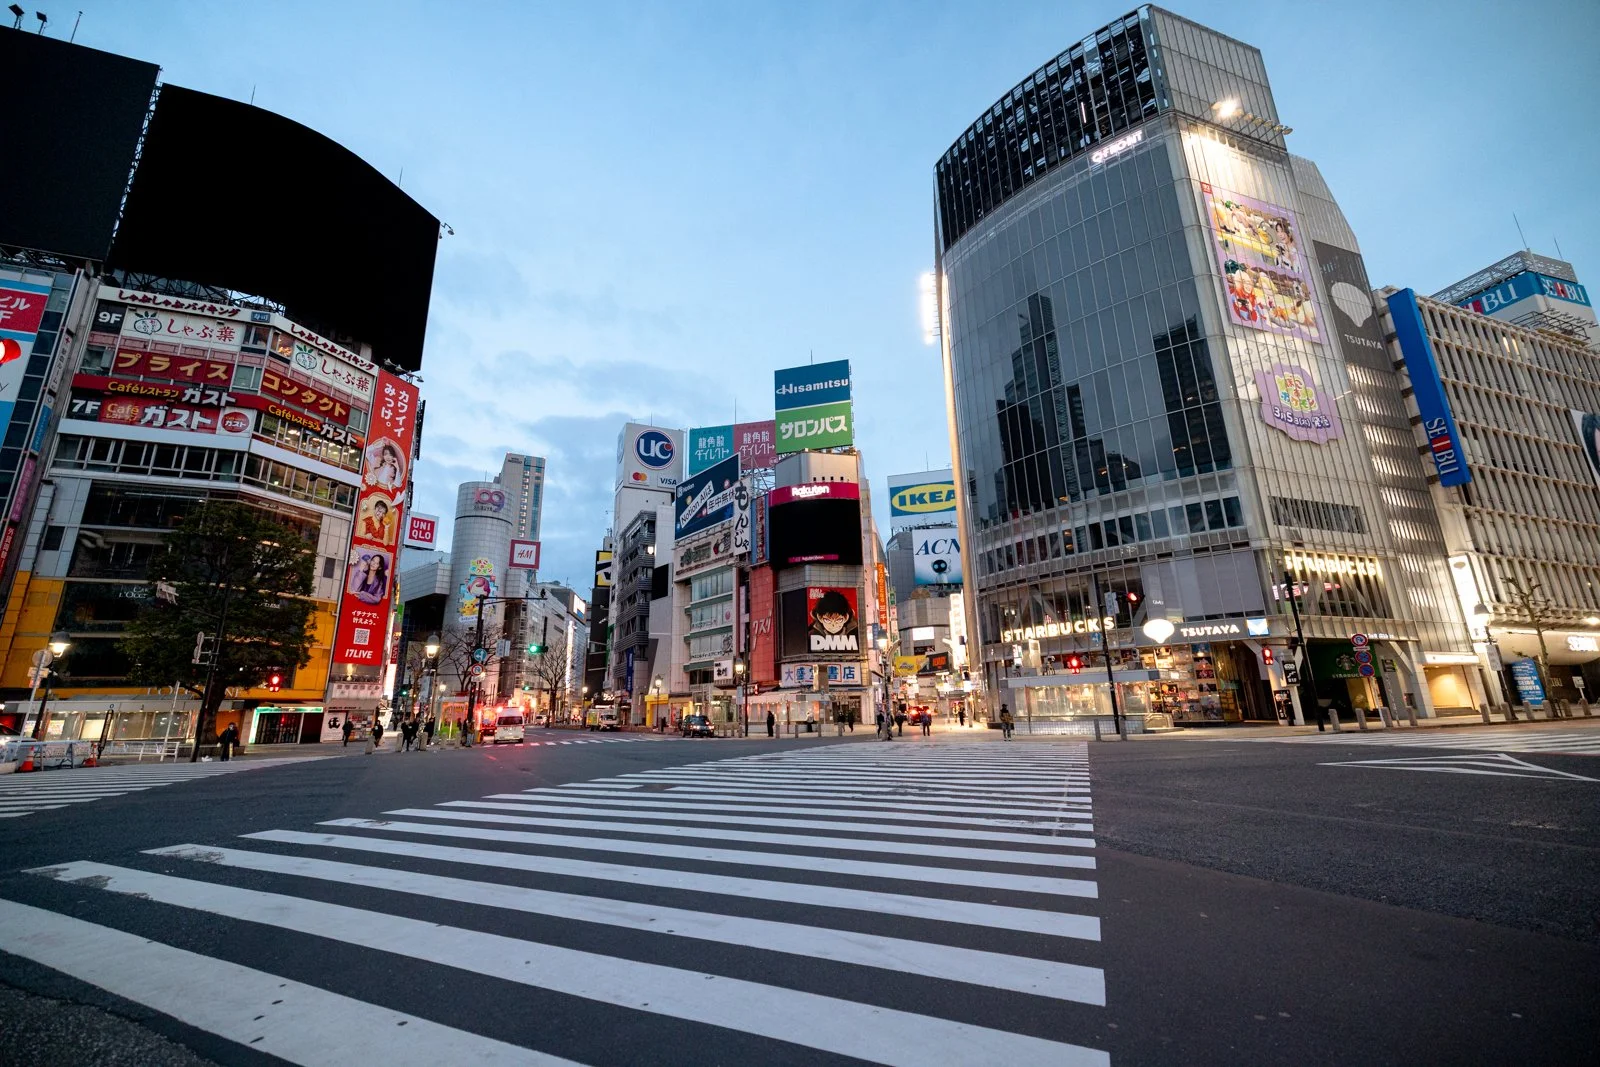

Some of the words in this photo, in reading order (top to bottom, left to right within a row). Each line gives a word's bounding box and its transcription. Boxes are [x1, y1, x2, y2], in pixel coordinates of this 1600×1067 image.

[1542, 278, 1585, 304] SEIBU
[119, 290, 240, 317] しゃぶしゃぶバイキング
[98, 311, 122, 325] 9F
[167, 318, 235, 342] しゃぶ葉
[291, 323, 375, 370] しゃぶしゃぶバイキング
[1344, 333, 1383, 350] TSUTAYA
[118, 352, 229, 380] プライス
[321, 359, 369, 392] しゃぶ葉
[183, 387, 236, 407] ガスト
[262, 372, 346, 418] コンタクト
[776, 378, 849, 395] Hisamitsu
[72, 399, 101, 414] 7F
[380, 383, 396, 427] みつけ。
[394, 390, 409, 437] カワイイ
[141, 405, 212, 430] ガスト
[224, 419, 247, 428] ガスト
[780, 415, 848, 440] サロンパス
[320, 423, 358, 448] ガスト
[1426, 417, 1459, 475] SEIBU
[639, 438, 672, 459] UC
[695, 447, 730, 461] ダイレクト
[739, 443, 775, 456] ダイレクト
[660, 478, 677, 486] VISA
[791, 485, 830, 498] Rakuten
[474, 488, 505, 512] 109
[681, 501, 701, 524] Notion
[734, 481, 749, 551] もんじゃ
[411, 529, 431, 541] QLO
[413, 519, 431, 531] UNI
[1284, 555, 1377, 576] STARBUCKS
[1003, 616, 1115, 643] STARBUCKS
[1180, 623, 1240, 638] TSUTAYA
[345, 648, 374, 659] 17LIVE
[810, 634, 858, 651] DMM
